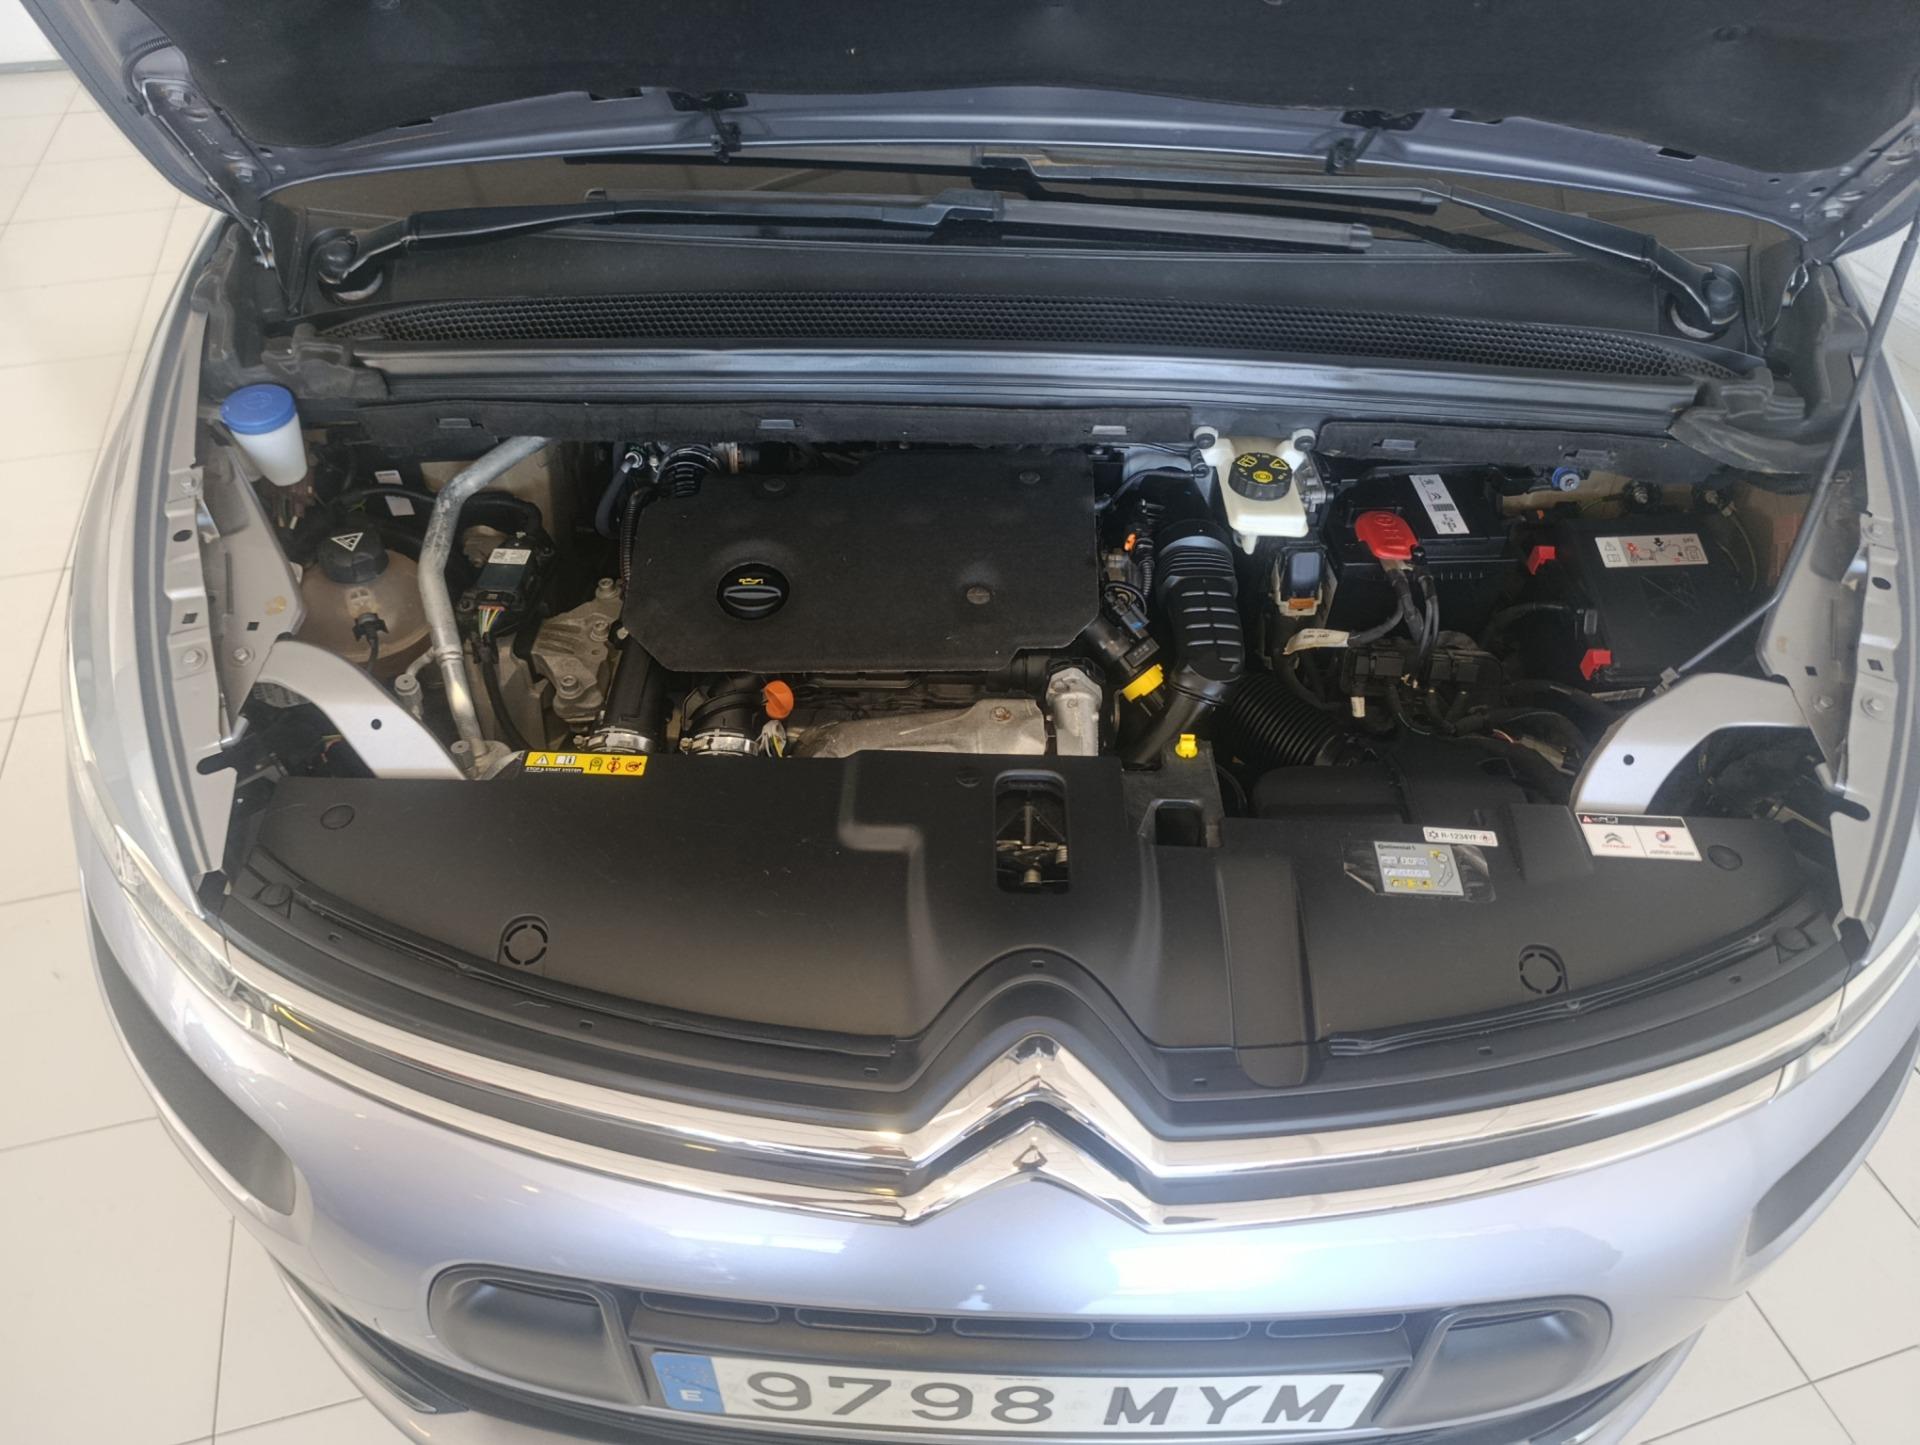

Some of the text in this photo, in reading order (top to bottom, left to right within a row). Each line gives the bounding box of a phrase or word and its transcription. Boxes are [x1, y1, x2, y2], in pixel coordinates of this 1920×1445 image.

[680, 1389, 704, 1402] E
[747, 1371, 1345, 1425] 9798 MYM
